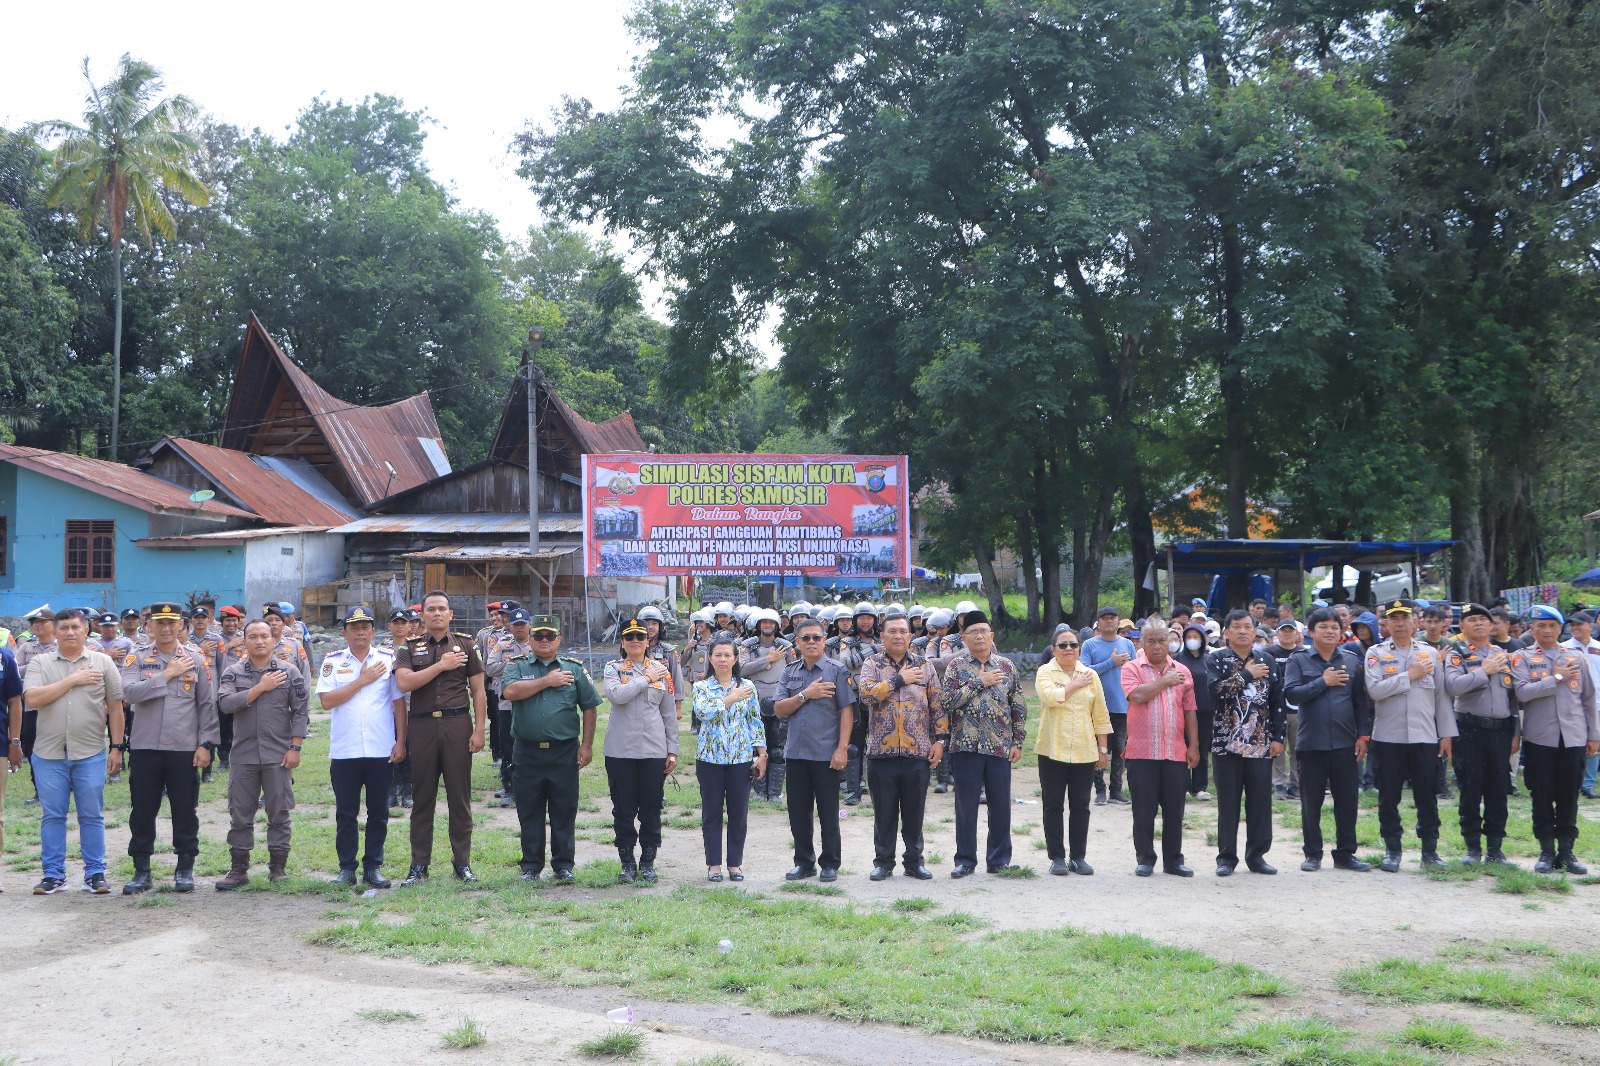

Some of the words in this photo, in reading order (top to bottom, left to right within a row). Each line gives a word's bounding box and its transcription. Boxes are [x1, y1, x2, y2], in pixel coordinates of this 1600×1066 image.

[639, 463, 730, 484] SIMULASI
[732, 463, 804, 484] SISPAM
[807, 463, 856, 484] KOTA
[668, 485, 738, 505] POLRES
[740, 485, 827, 505] SAMOSIR
[691, 507, 741, 520] Dalam
[745, 507, 802, 524] Rangka
[650, 526, 712, 539] ANTISIPASI
[713, 526, 773, 539] GANGGUAN
[775, 525, 842, 539] KAMTIBMAS
[623, 540, 646, 553] DAN
[648, 540, 701, 553] KESIAPAN
[702, 540, 774, 553] PENANGANAN
[775, 540, 802, 553] AKSI
[803, 539, 839, 553] UNJUK
[840, 539, 870, 553] RASA
[657, 553, 717, 566] DIWILAYAH
[720, 553, 783, 566] KABUPATEN
[785, 553, 836, 566] SAMOSIR
